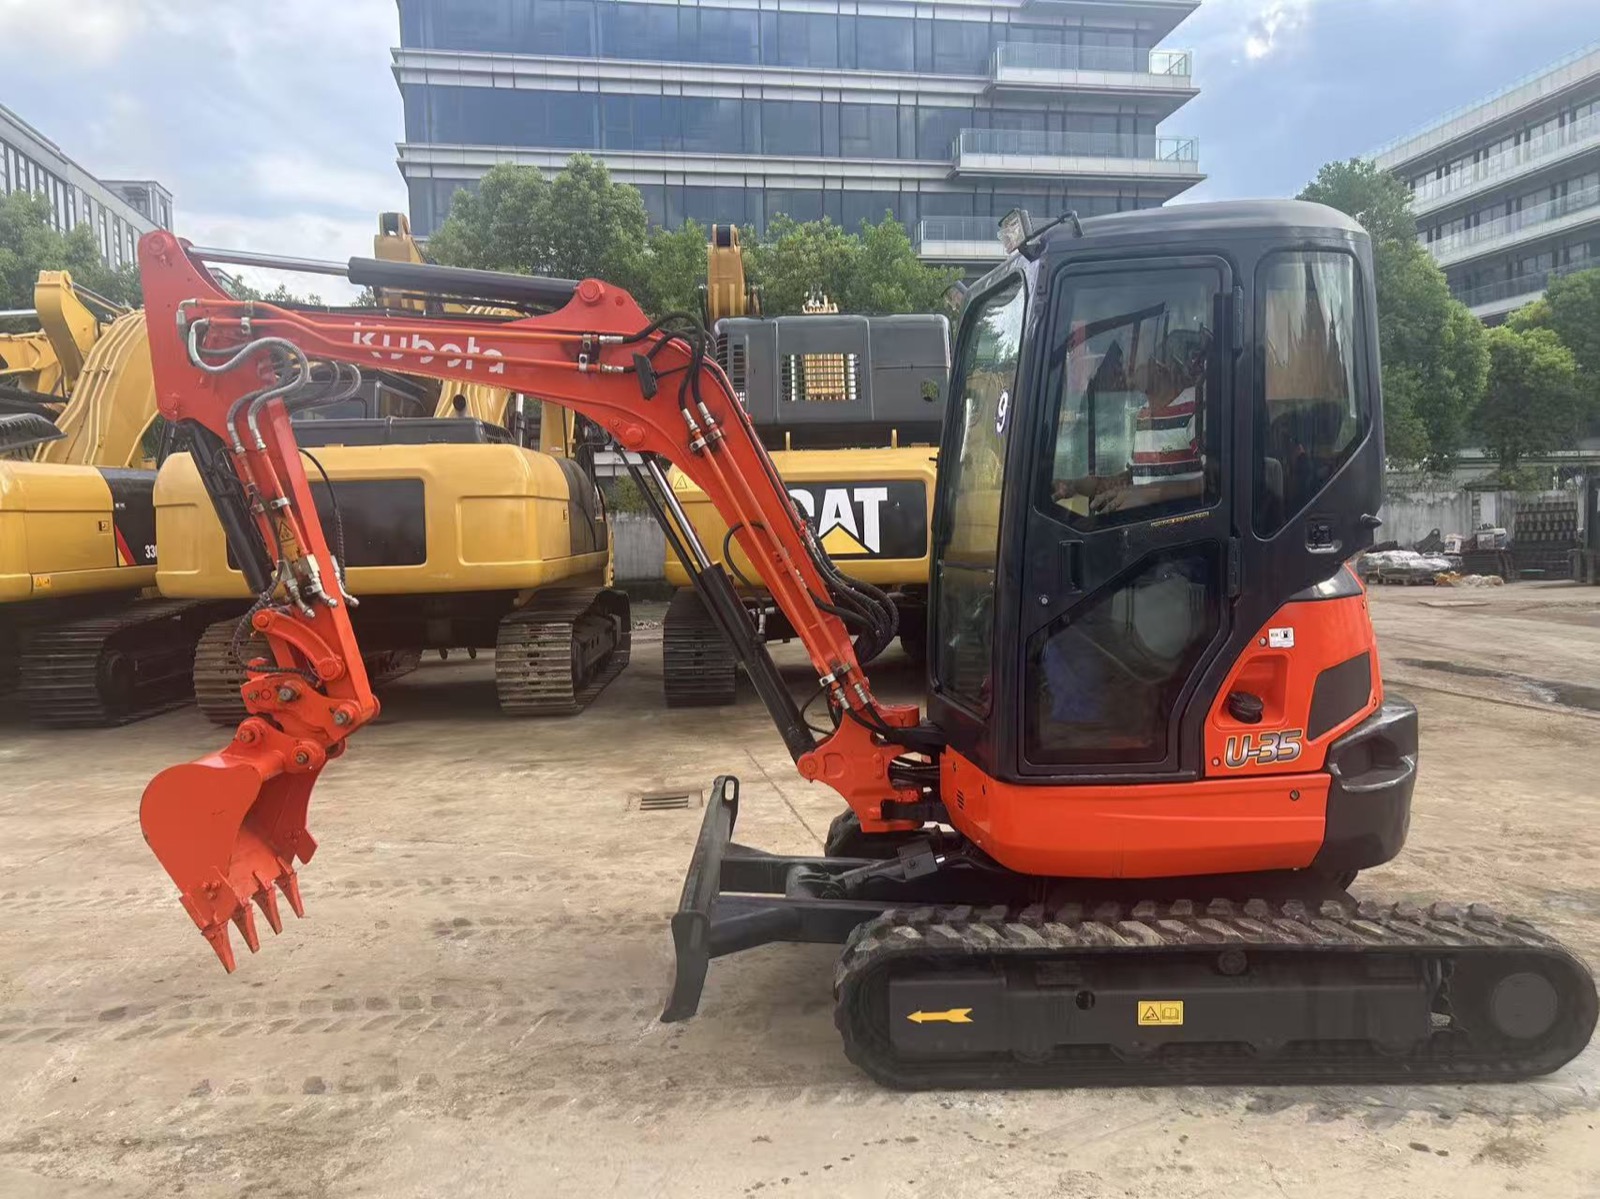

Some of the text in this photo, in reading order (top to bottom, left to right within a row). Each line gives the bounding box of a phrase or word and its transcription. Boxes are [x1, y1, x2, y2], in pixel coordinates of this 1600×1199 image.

[353, 322, 504, 373] Kubota
[996, 391, 1008, 432] 9
[1225, 730, 1303, 768] U-35
